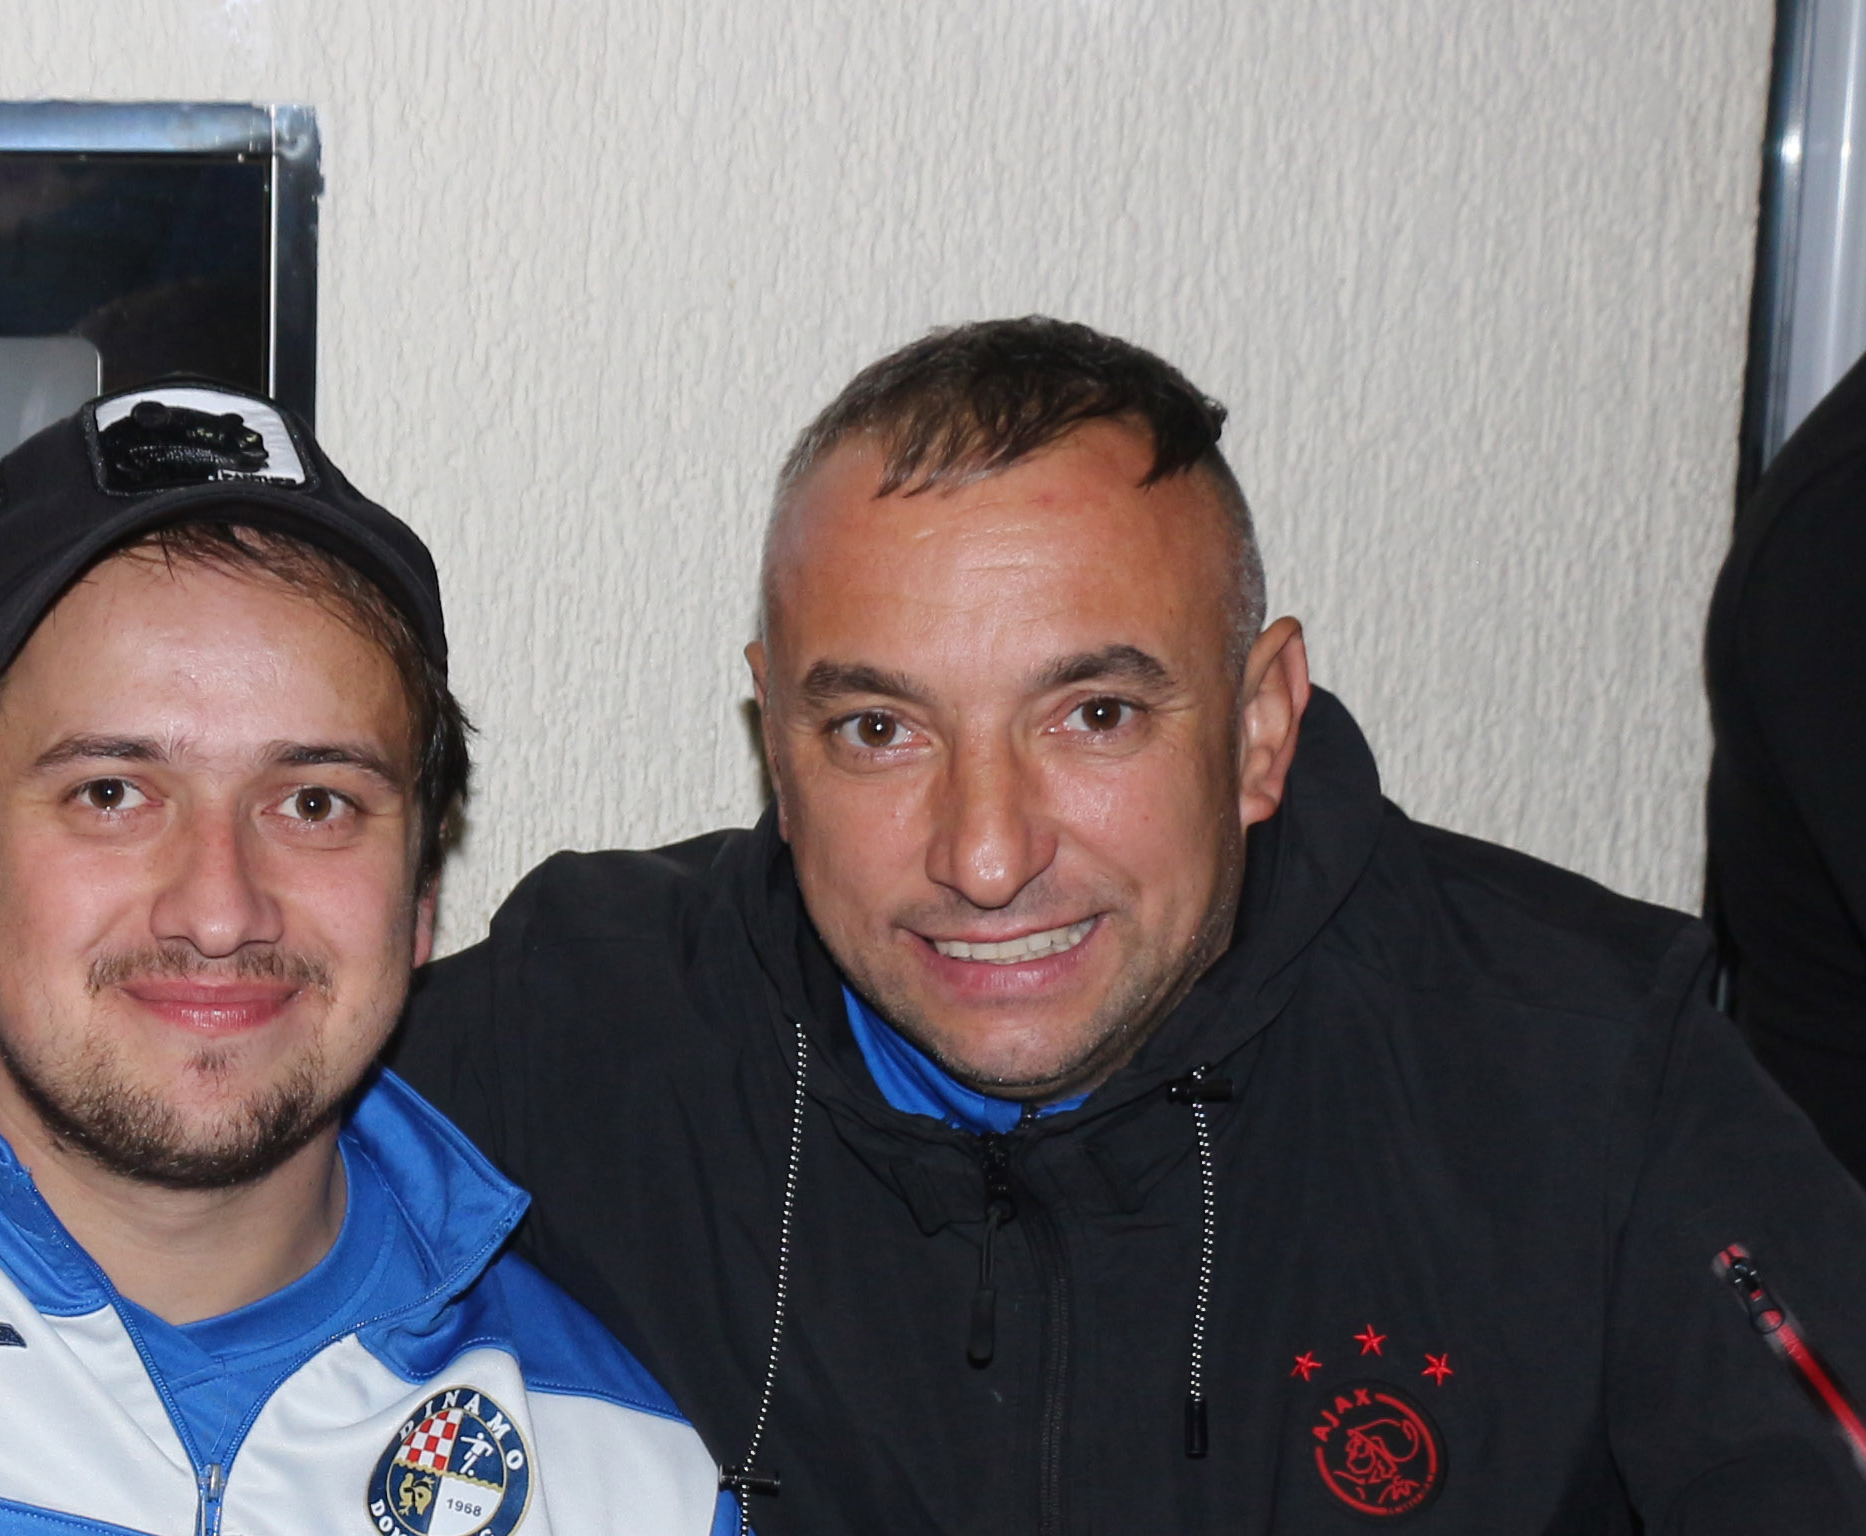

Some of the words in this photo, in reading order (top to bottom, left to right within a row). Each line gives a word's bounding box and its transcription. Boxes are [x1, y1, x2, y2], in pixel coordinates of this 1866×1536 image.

[398, 1389, 524, 1471] DINAMO
[1312, 1388, 1371, 1442] AJAX
[446, 1498, 482, 1517] 1968
